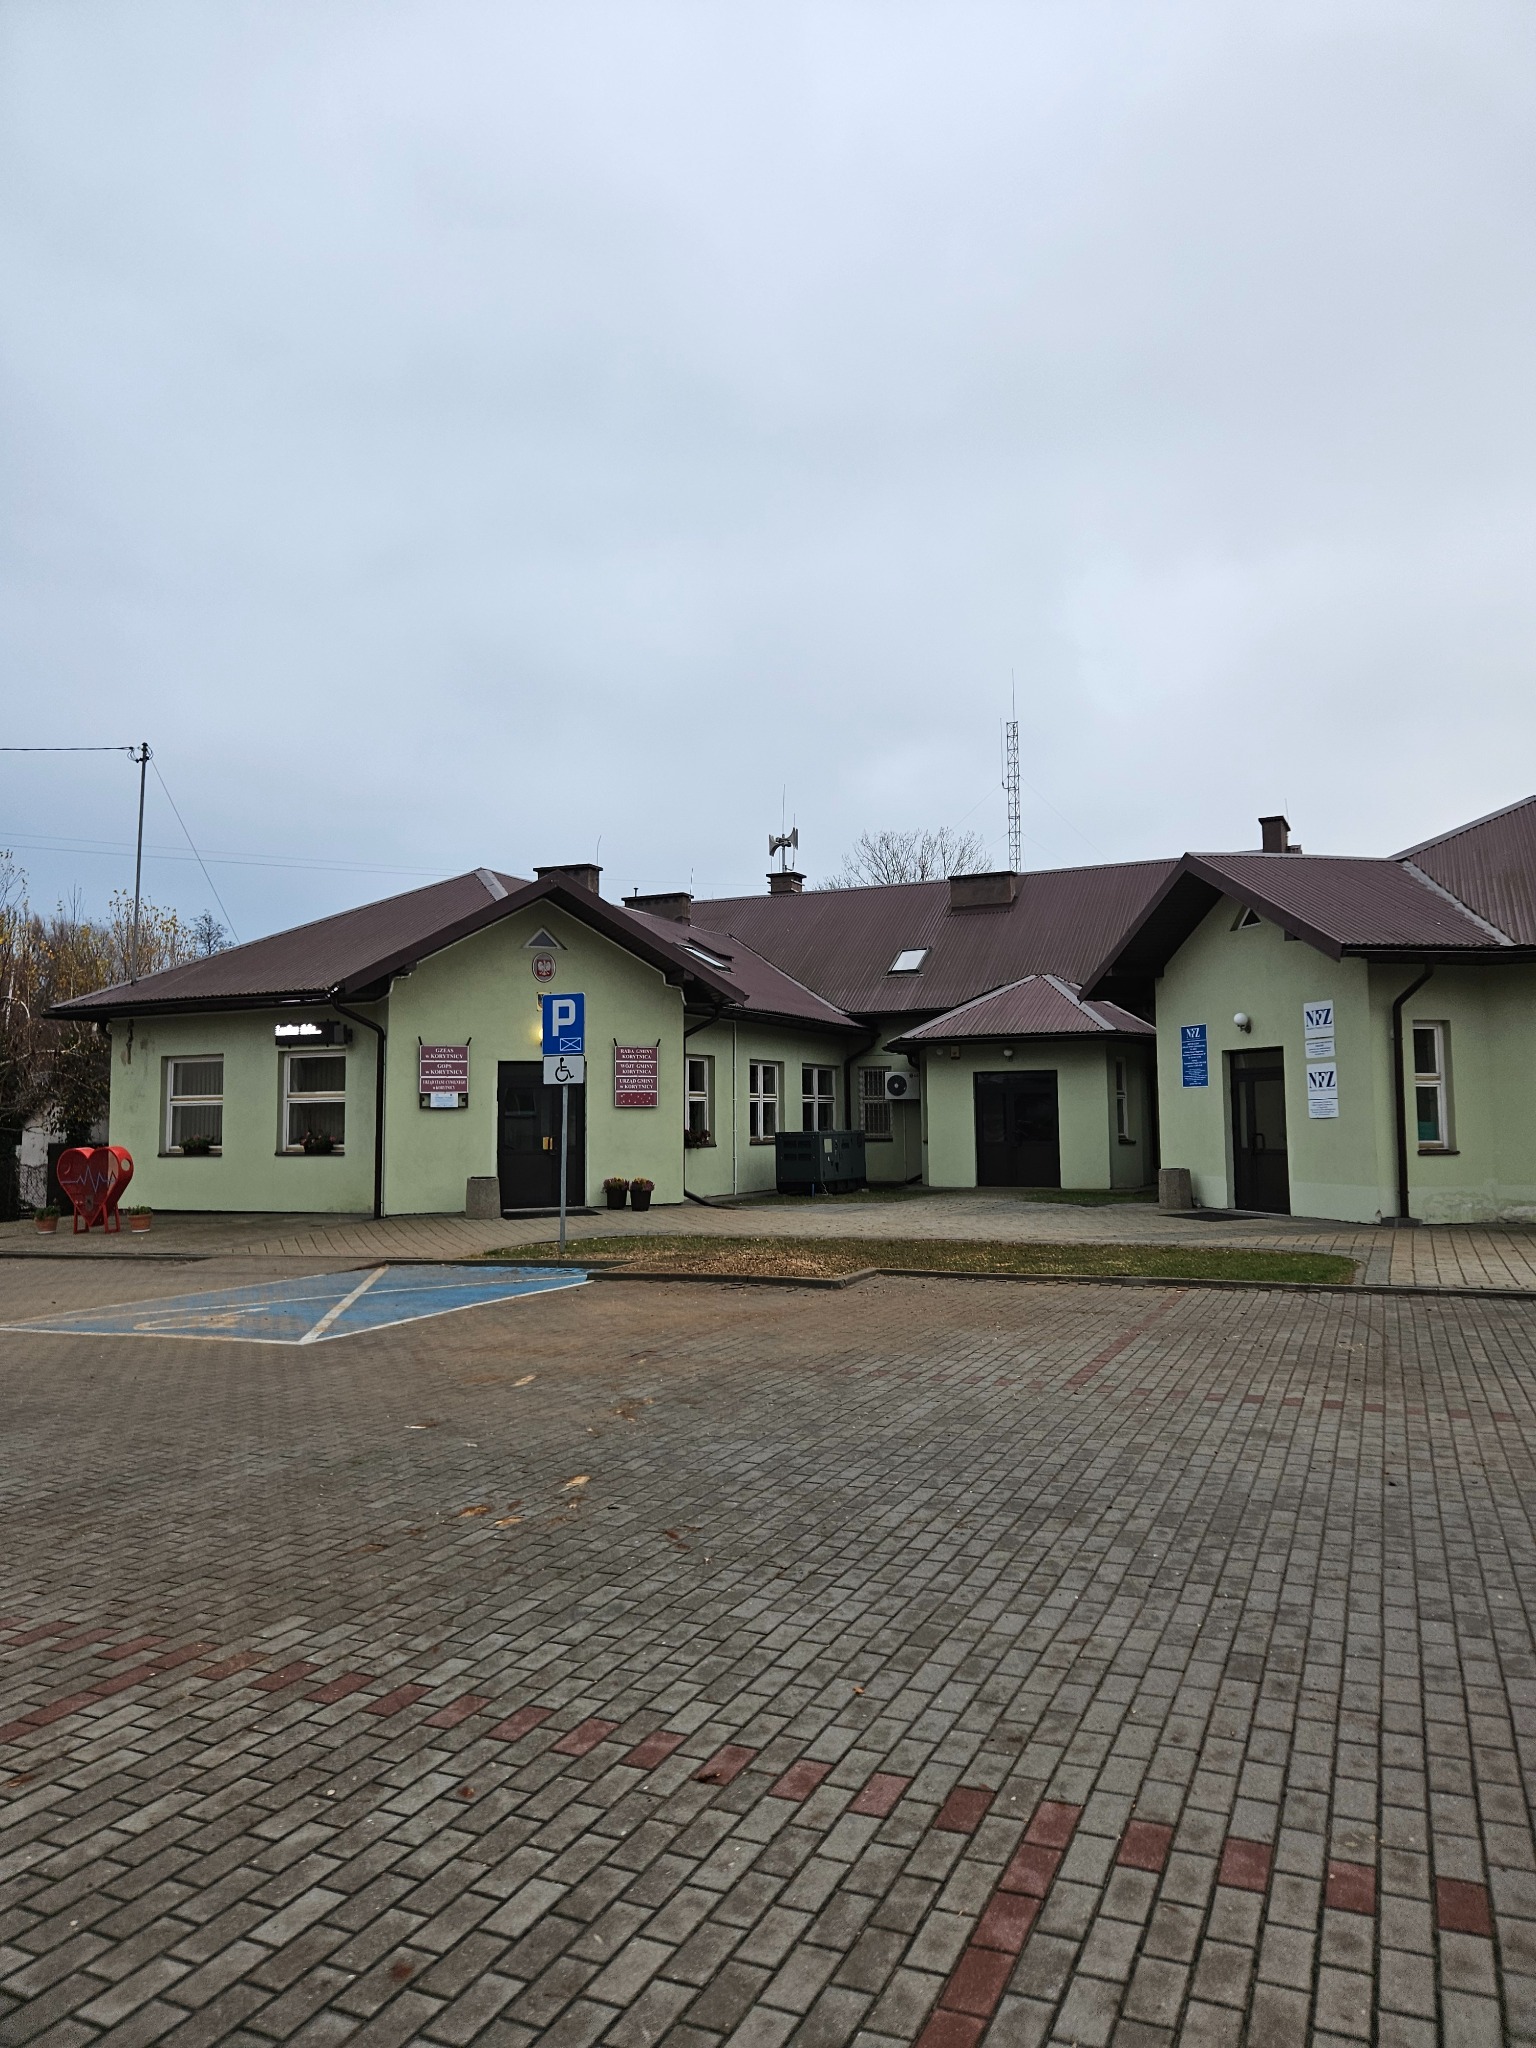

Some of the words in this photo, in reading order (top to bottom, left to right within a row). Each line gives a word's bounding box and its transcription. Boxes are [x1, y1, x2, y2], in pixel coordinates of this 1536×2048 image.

[552, 998, 576, 1037] P
[1305, 1007, 1333, 1027] NFZ
[1186, 1027, 1201, 1039] NFZ
[1308, 1070, 1336, 1088] NFZ
